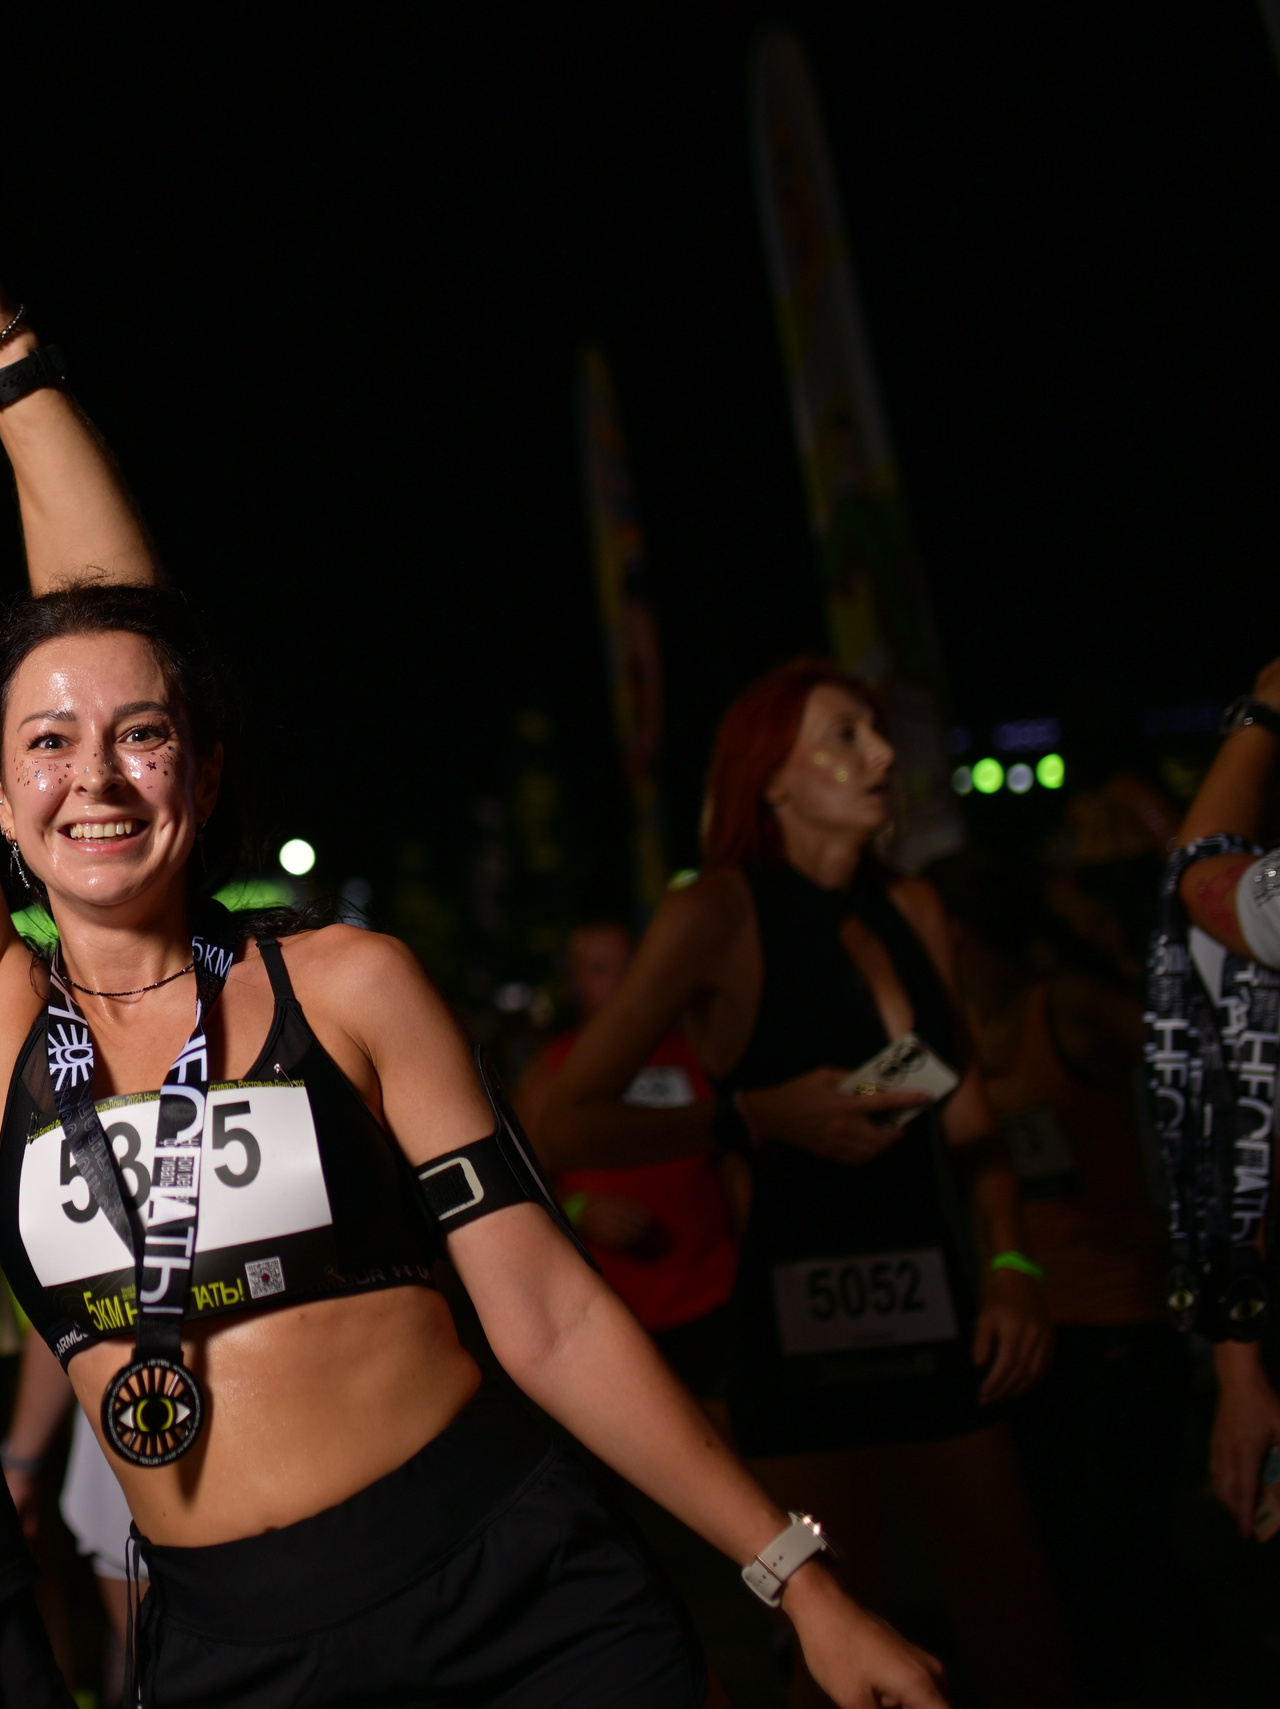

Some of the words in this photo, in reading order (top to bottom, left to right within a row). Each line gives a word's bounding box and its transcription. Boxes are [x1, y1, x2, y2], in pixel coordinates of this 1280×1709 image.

[59, 1100, 261, 1224] 535
[83, 1290, 125, 1331] 5КМ
[808, 1262, 925, 1320] 5052
